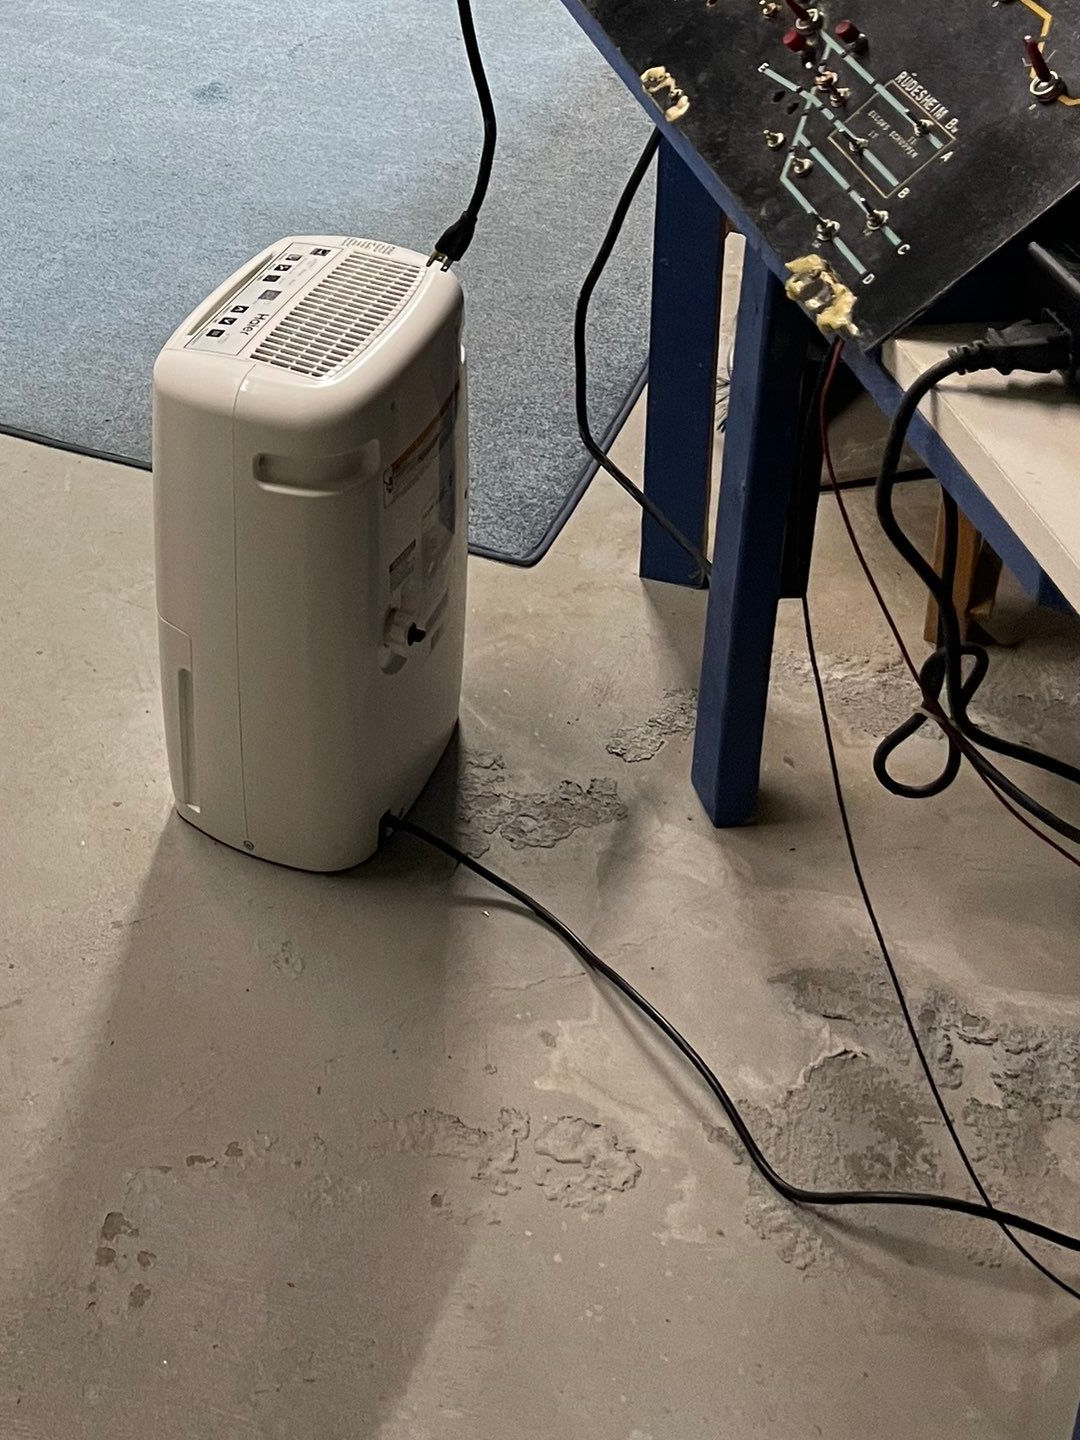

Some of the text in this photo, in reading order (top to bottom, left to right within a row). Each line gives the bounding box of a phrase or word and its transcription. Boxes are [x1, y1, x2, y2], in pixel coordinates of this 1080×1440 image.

[939, 151, 954, 164] A
[897, 187, 911, 199] B
[897, 243, 911, 255] C
[862, 273, 875, 285] D
[240, 313, 270, 335] Haier
